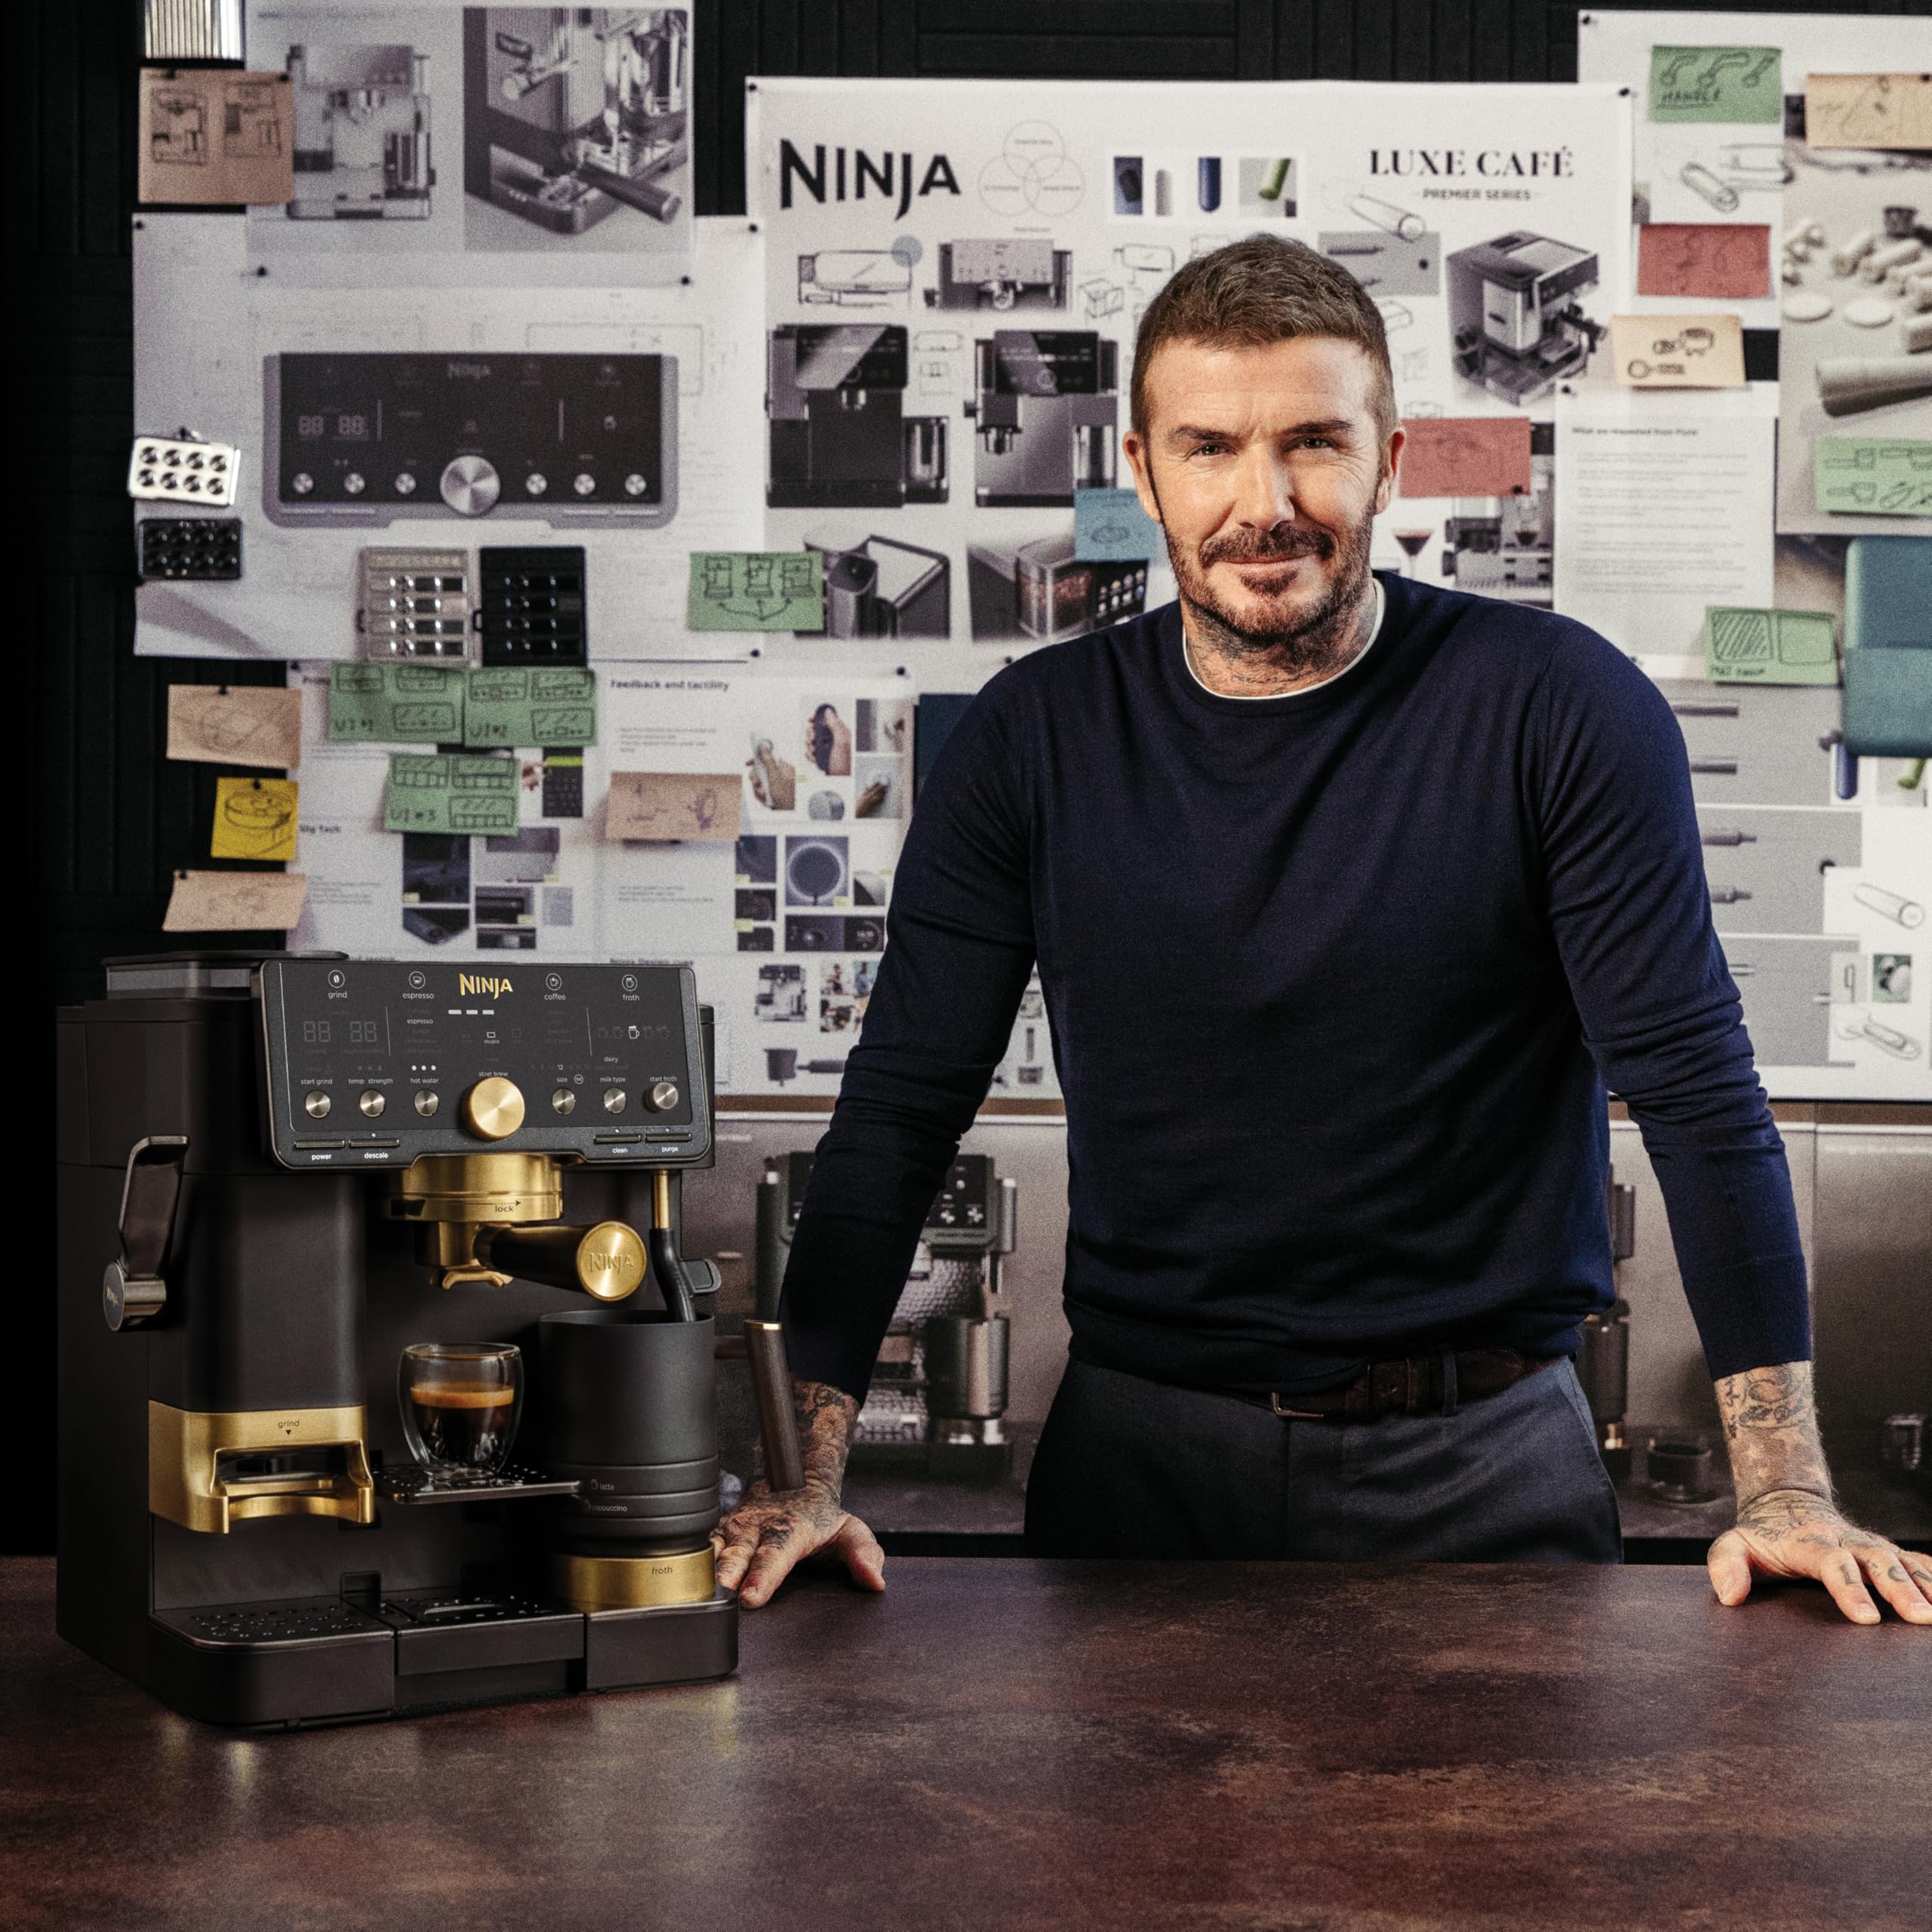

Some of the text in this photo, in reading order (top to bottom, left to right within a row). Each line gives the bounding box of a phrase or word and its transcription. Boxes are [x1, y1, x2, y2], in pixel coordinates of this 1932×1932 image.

[1370, 145, 1574, 178] LUXE CAFÉ
[780, 138, 961, 221] NINJA
[1423, 188, 1531, 201] PREMIER SERIES
[611, 679, 661, 689] Feedback
[665, 680, 685, 689] and
[459, 973, 513, 999] NINJA
[328, 991, 347, 999] grind
[311, 1153, 332, 1161] power
[589, 1253, 634, 1274] NINJA
[278, 1419, 300, 1429] grind
[599, 1481, 615, 1491] latte
[591, 1503, 628, 1512] cappuccino
[651, 1566, 673, 1576] froth
